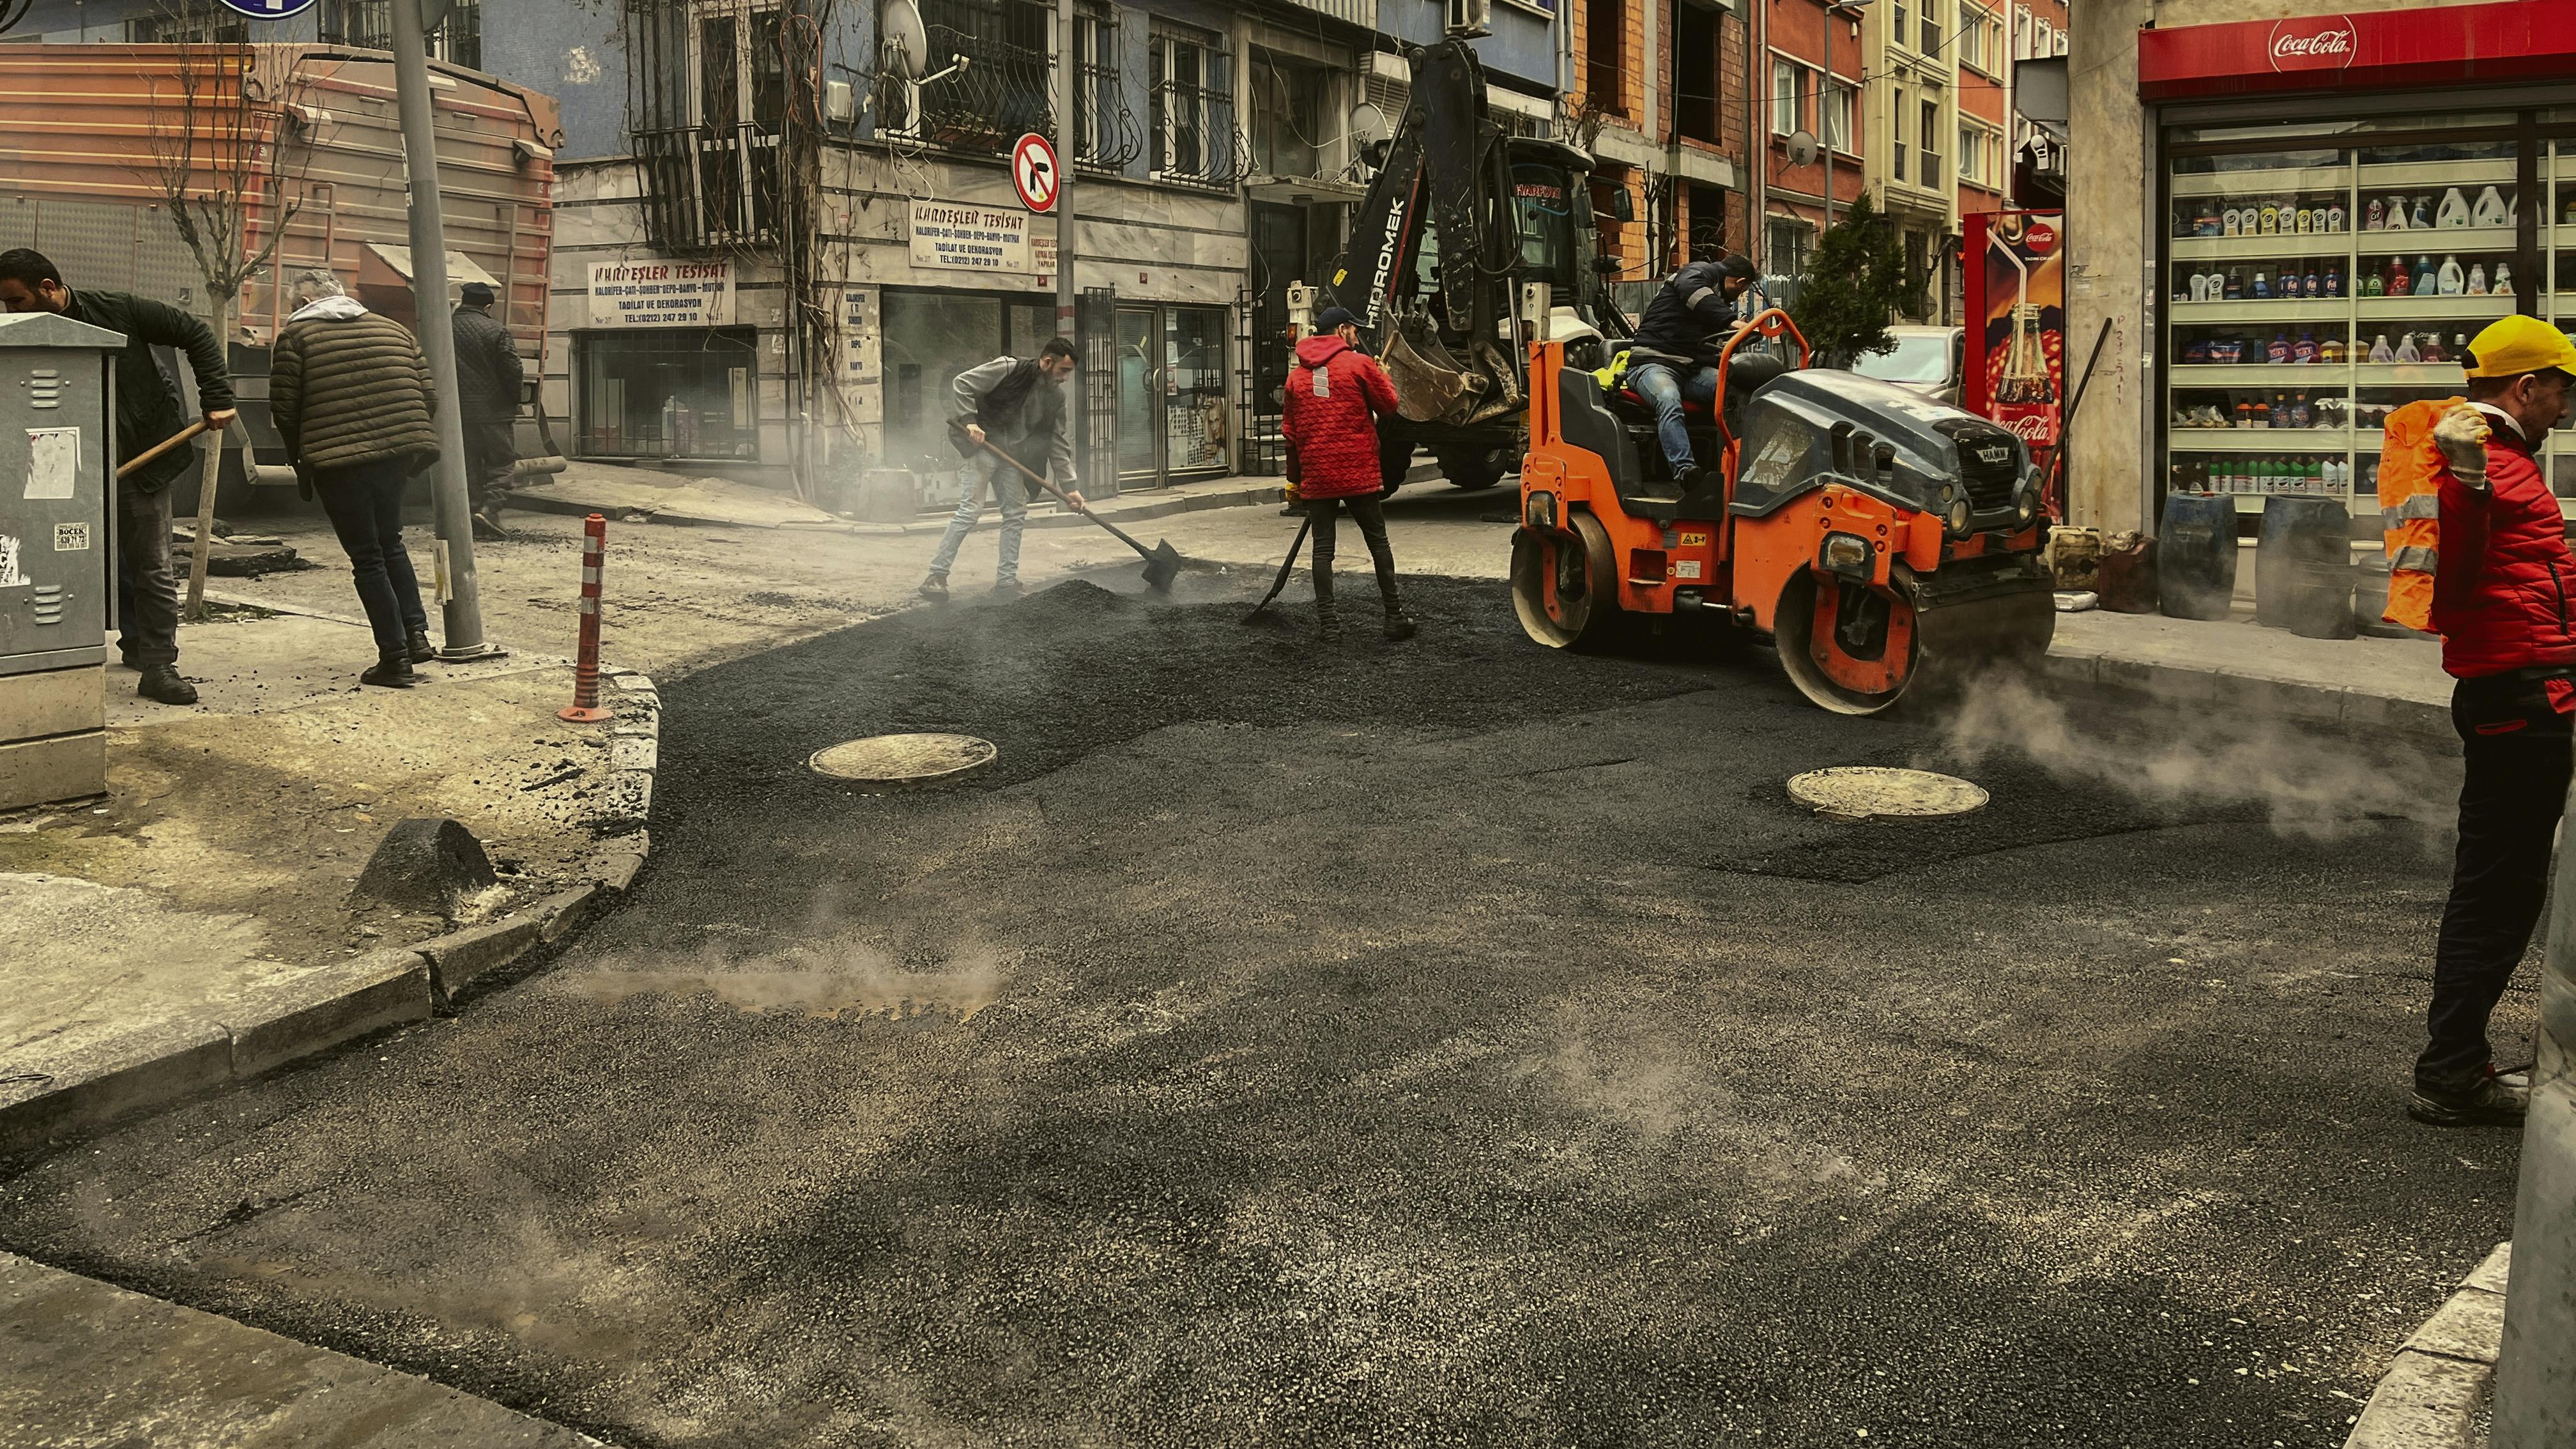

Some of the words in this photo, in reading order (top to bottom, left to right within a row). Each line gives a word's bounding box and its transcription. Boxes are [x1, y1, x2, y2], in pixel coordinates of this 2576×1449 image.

[2274, 30, 2352, 57] Coca-Cola
[2026, 233, 2055, 242] Coca-Cola
[935, 241, 957, 253] TADİLAT
[959, 244, 966, 253] VE
[967, 245, 1002, 256] DEKORASYON
[971, 257, 982, 266] 247
[618, 299, 644, 310] TADİLAT
[647, 300, 655, 309] VE
[657, 298, 702, 309] DEKORASYON
[663, 313, 675, 322] 247
[678, 312, 687, 321] 29
[689, 312, 697, 321] 10
[1983, 448, 2005, 460] HAMM
